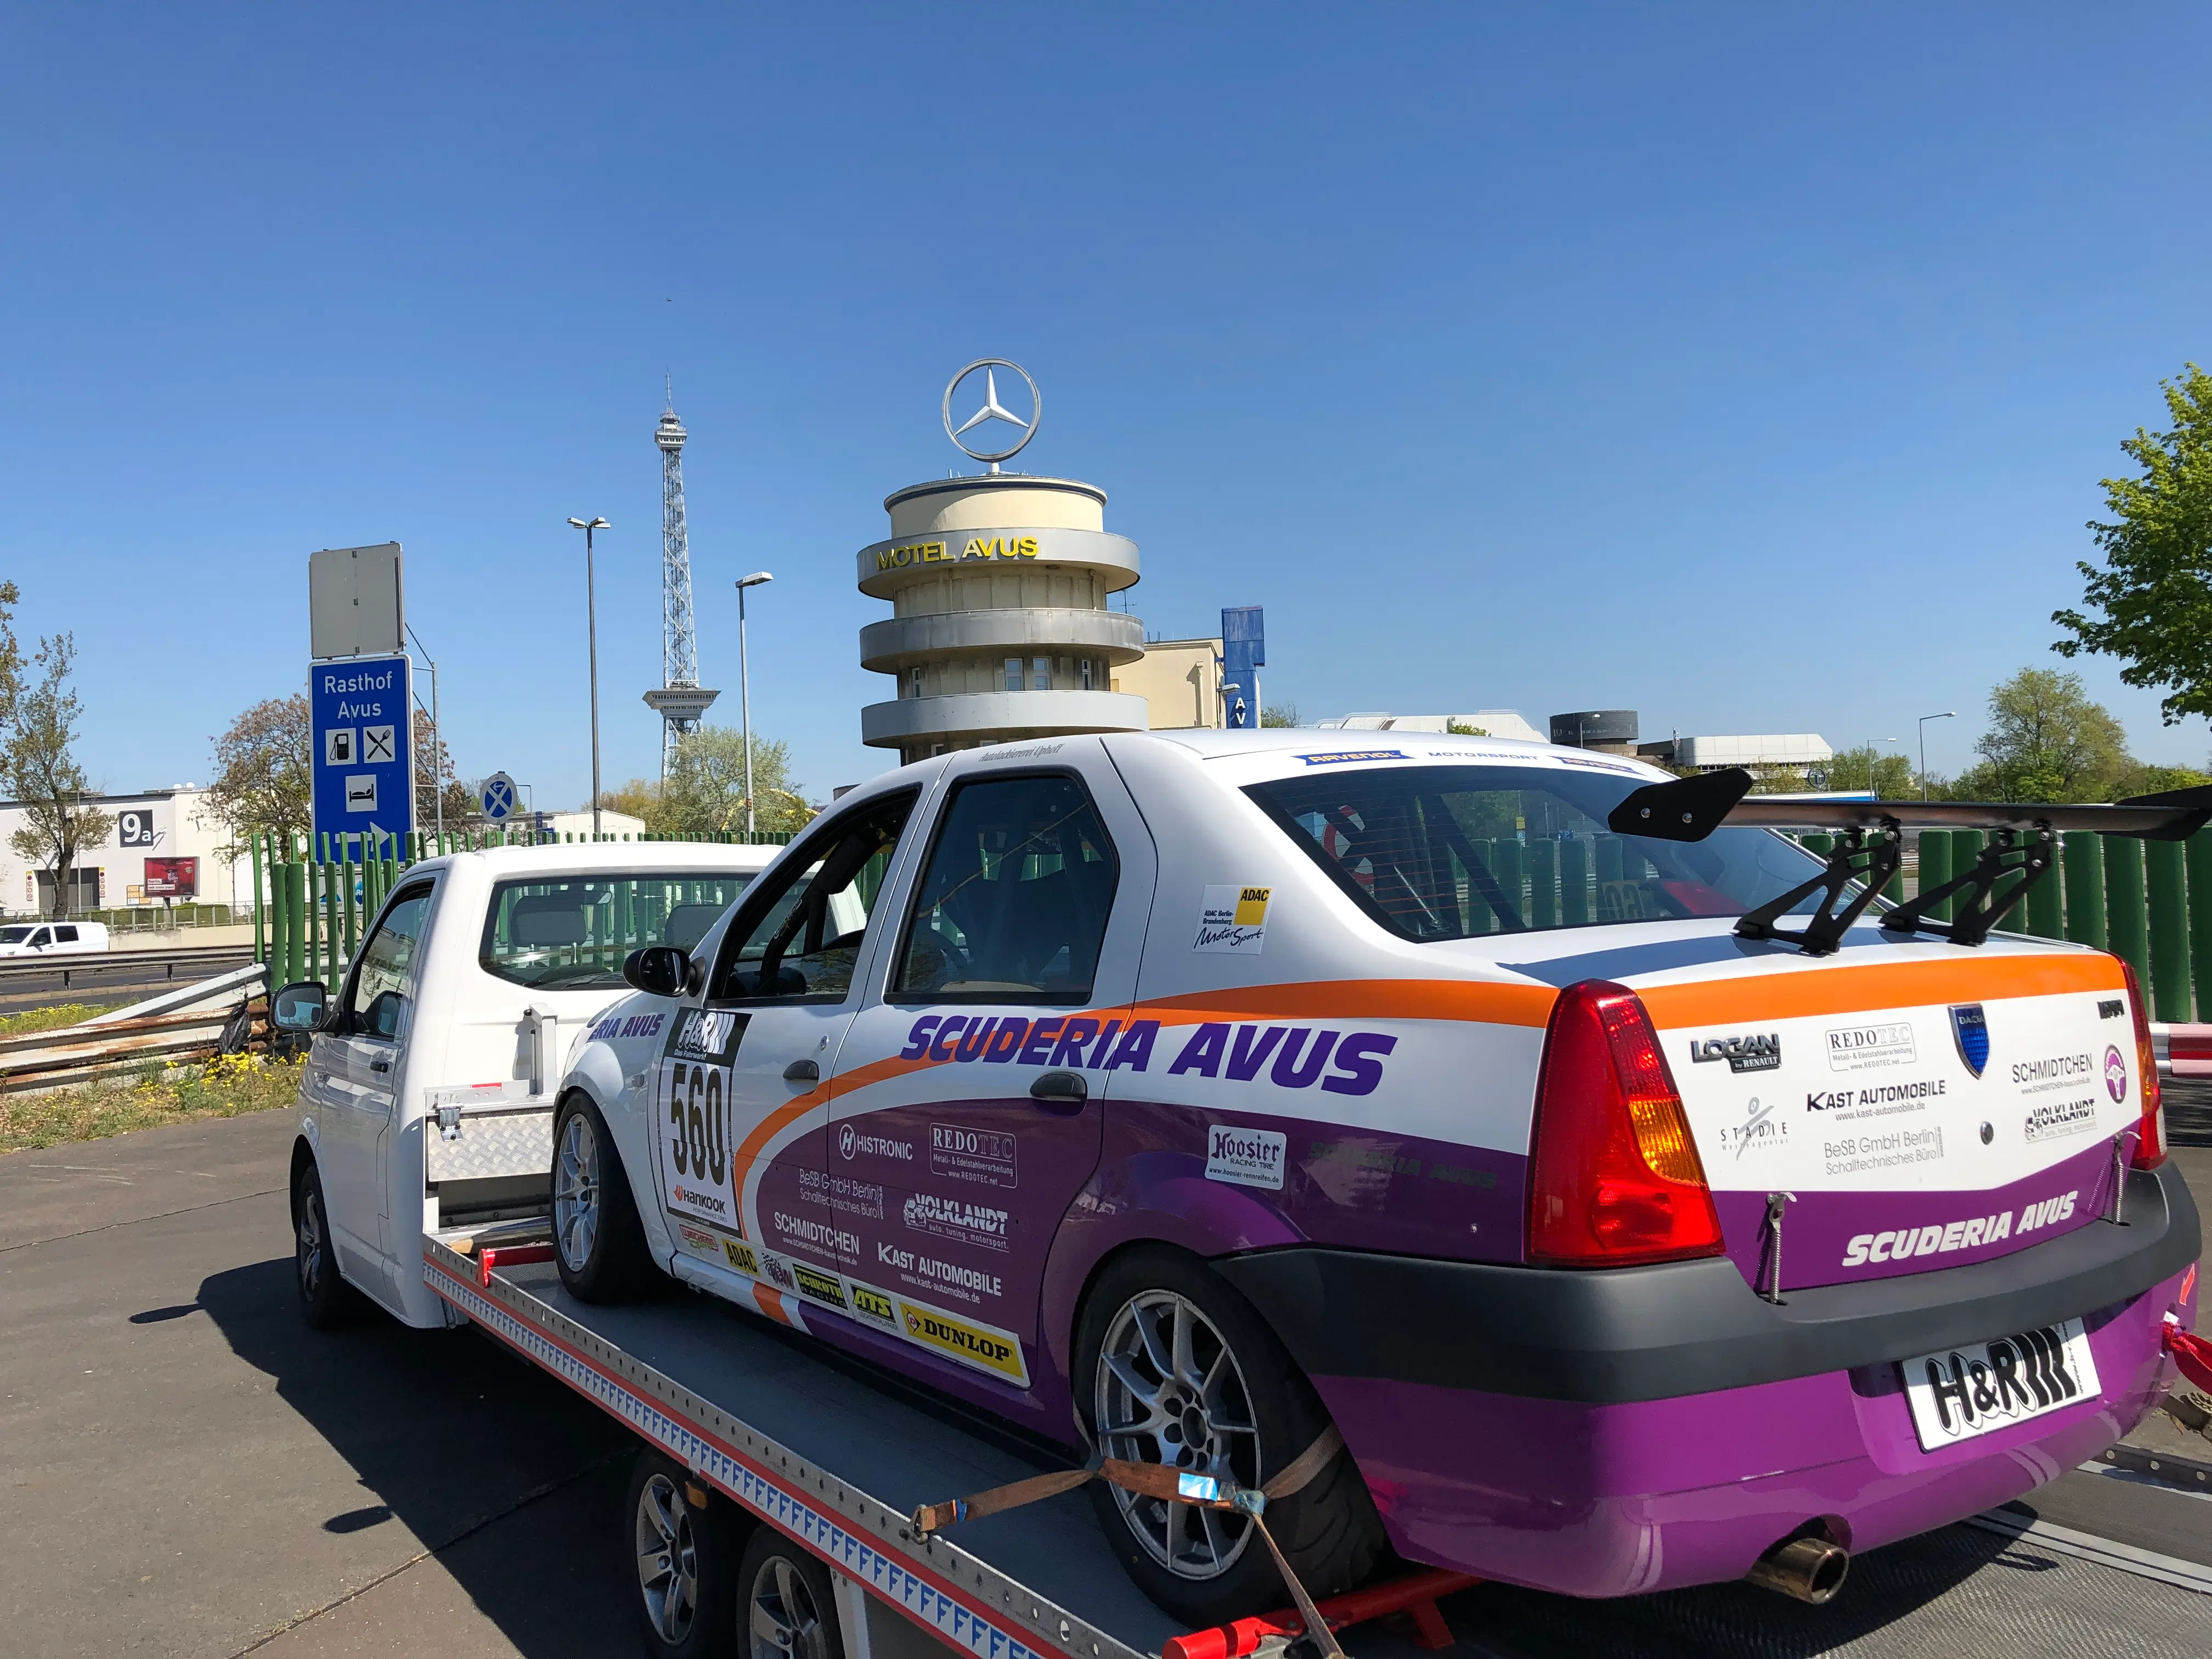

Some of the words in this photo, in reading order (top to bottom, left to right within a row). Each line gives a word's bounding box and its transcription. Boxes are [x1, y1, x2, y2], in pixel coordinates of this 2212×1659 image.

[878, 541, 955, 570] MOTEL
[962, 537, 1039, 557] AVUS
[325, 670, 392, 694] Rasthof
[338, 701, 381, 719] Avus
[1240, 889, 1269, 901] ADAC
[619, 1013, 665, 1037] AVUS
[1958, 1015, 1985, 1025] DACIA
[1690, 1032, 1780, 1063] LOGAN
[1829, 1026, 1910, 1049] REDOTEC
[899, 1015, 1161, 1072] SCUDERIA
[1167, 1022, 1398, 1096] AVUS
[1743, 1056, 1778, 1068] RENAULT
[2012, 1053, 2093, 1084] SCHMIDTCHEN
[1859, 1080, 1946, 1105] AUTOMOBILE
[671, 1063, 725, 1186] 560
[1835, 1101, 1926, 1121] www.kast-automobile.de
[857, 1136, 913, 1160] HISTRONIC
[933, 1127, 1013, 1159] REDOTEC
[1211, 1131, 1280, 1163] Hoosier
[1824, 1139, 1857, 1158] BeSB
[1859, 1133, 1900, 1153] GmbH
[1903, 1128, 1936, 1147] Berlin
[933, 1154, 951, 1164] Metall-
[952, 1156, 956, 1165] &
[957, 1157, 1014, 1177] Edelstahlverarbeitung
[1209, 1167, 1279, 1183] www.hoosier-rennreifen.de
[1230, 1158, 1256, 1167] RACING
[1259, 1161, 1274, 1170] TIRE
[1826, 1153, 1914, 1175] Schalltechnisches
[1916, 1148, 1937, 1162] Büro
[799, 1169, 820, 1187] BeSB
[822, 1173, 851, 1195] GmbH
[853, 1180, 878, 1200] Berlin
[800, 1187, 860, 1214] Schalltechnisches
[861, 1203, 877, 1218] Büro
[774, 1211, 860, 1255] SCHMIDTCHEN
[1842, 1210, 2012, 1266] SCUDERIA
[2016, 1190, 2078, 1234] AVUS
[726, 1242, 758, 1273] ADAC
[900, 1273, 981, 1304] www.kast-automobile.de
[918, 1256, 1002, 1296] AUTOMOBILE
[853, 1289, 891, 1317] ATS
[923, 1317, 1009, 1362] DUNLOP
